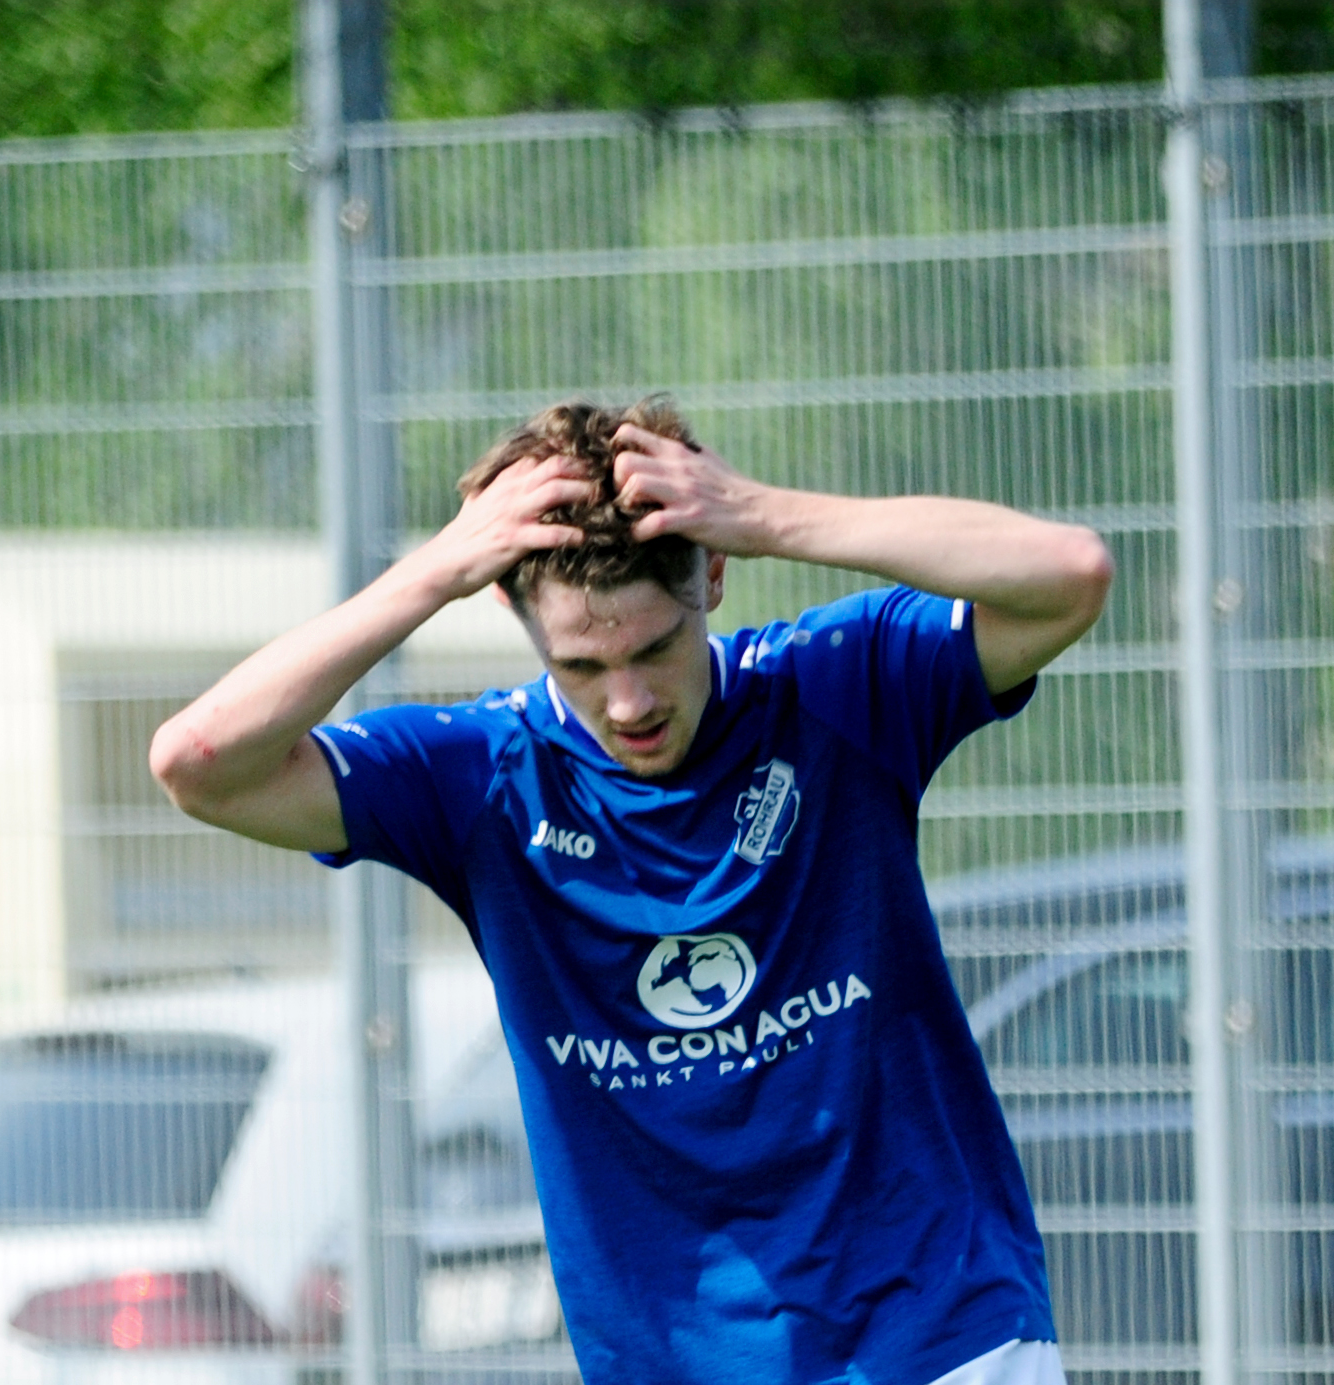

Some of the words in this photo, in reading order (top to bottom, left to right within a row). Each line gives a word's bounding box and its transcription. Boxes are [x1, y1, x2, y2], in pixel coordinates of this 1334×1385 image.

[532, 820, 595, 859] JAKO
[747, 775, 785, 850] ROHRAU
[547, 1035, 639, 1070] VIVA
[648, 1025, 748, 1065] CON
[756, 974, 872, 1045] AGUA
[590, 1066, 695, 1091] SANKT
[719, 1031, 814, 1075] PAULI
